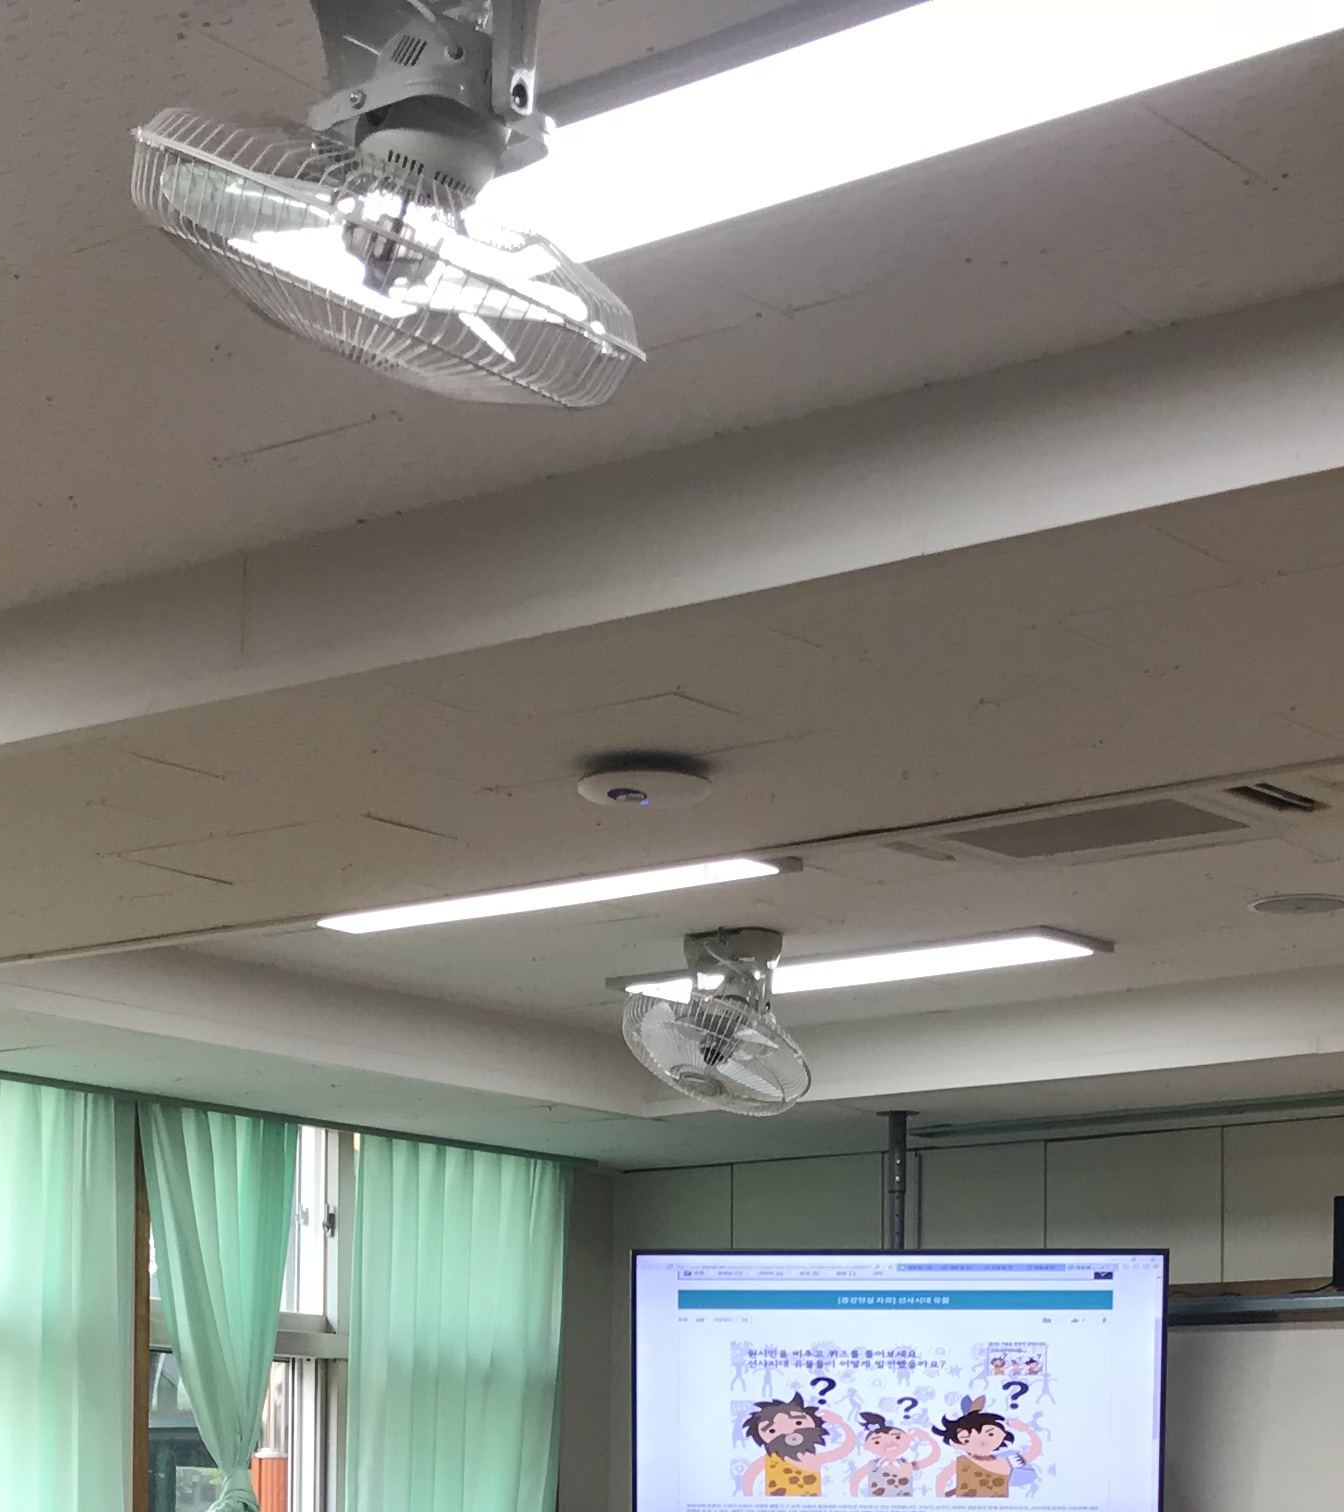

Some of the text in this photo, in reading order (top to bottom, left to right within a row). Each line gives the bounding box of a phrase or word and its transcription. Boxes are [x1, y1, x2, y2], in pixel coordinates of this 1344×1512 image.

[899, 1296, 931, 1305] 선사시대
[829, 1349, 860, 1358] 퀴즈를
[748, 1359, 789, 1369] 선사시대
[840, 1359, 871, 1369] 어떻게
